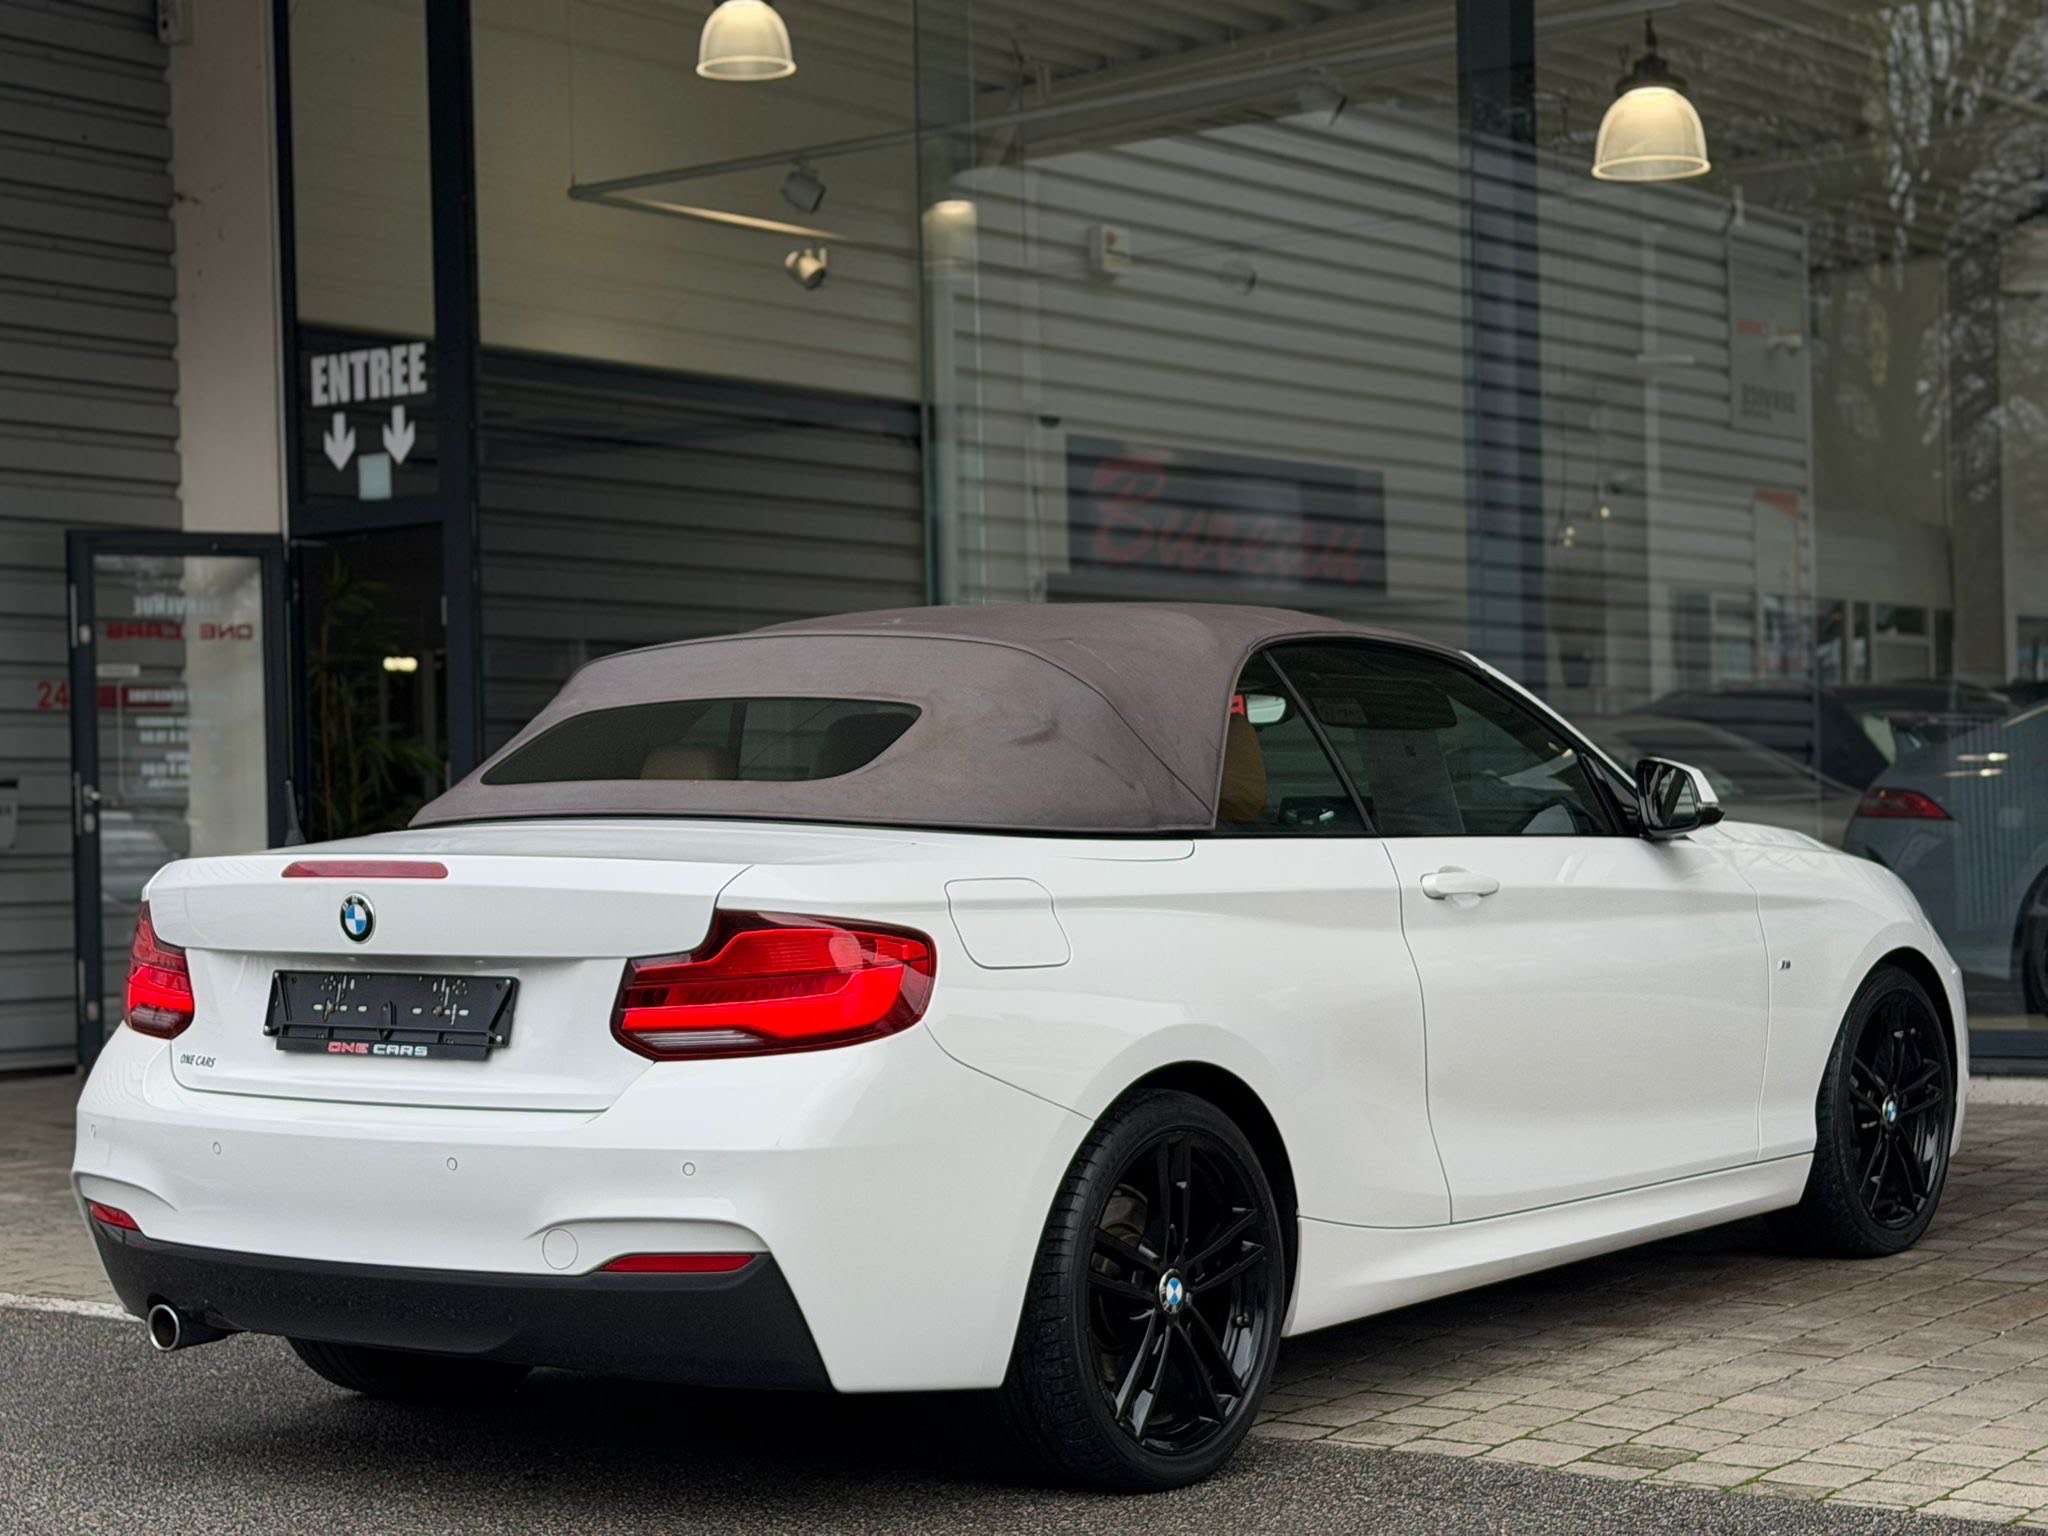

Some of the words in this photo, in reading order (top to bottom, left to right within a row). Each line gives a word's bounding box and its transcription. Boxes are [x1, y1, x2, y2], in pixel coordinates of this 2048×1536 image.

[311, 342, 427, 407] ENTREE
[328, 1041, 369, 1054] ONE
[373, 1044, 428, 1057] CARS
[180, 1053, 195, 1065] ONE
[195, 1055, 216, 1068] CARS
